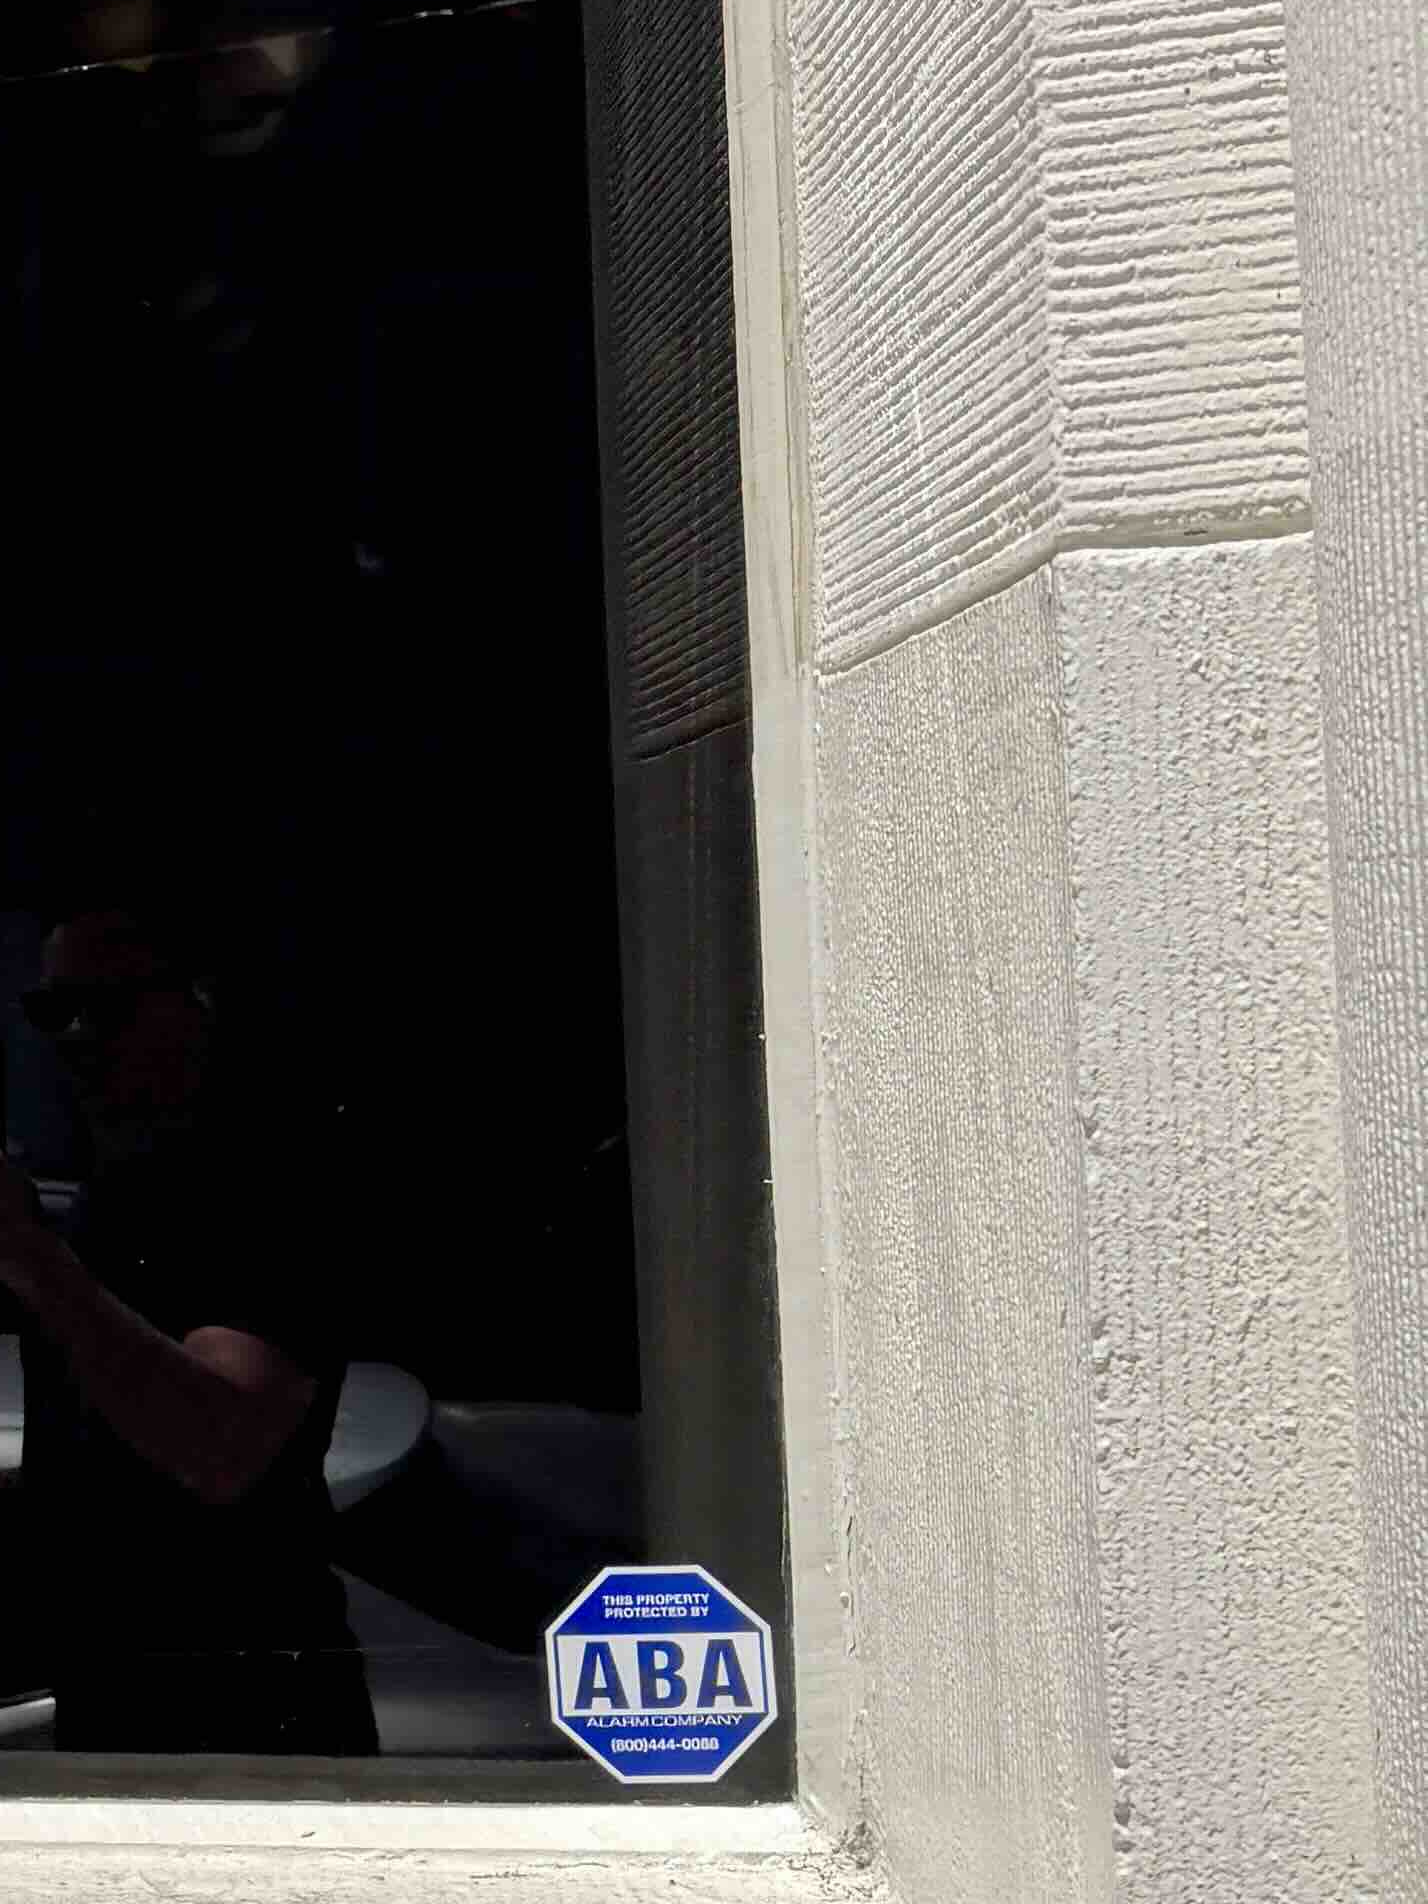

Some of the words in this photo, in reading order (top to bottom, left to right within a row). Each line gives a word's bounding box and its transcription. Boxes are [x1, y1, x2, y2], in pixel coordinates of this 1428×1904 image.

[602, 1595, 634, 1606] THIS
[637, 1593, 710, 1606] PROPERTY
[605, 1606, 686, 1619] PROTECTED
[690, 1606, 709, 1617] BY
[573, 1639, 753, 1710] ABA
[586, 1716, 650, 1728] ALARM
[651, 1714, 743, 1727] COMPANY
